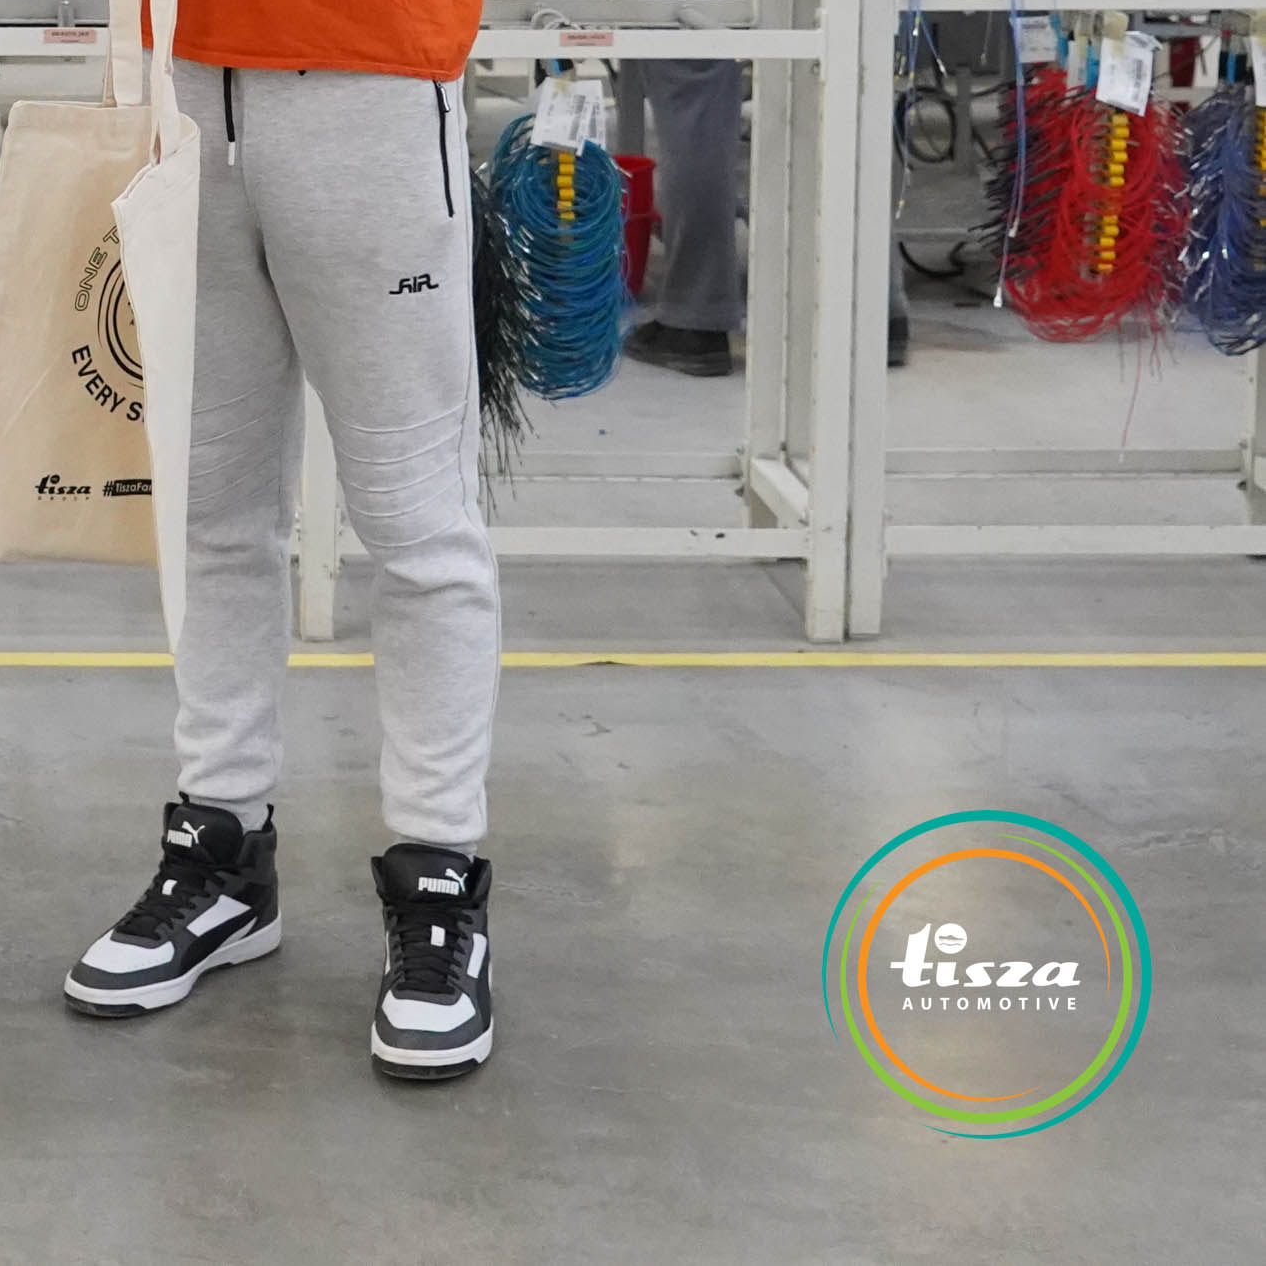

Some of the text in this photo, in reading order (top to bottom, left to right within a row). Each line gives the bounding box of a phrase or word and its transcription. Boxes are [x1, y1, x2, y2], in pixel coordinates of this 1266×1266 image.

[74, 225, 120, 312] ONE T
[72, 345, 145, 422] EVERY S
[35, 474, 91, 495] tisza
[418, 876, 460, 896] PUMA
